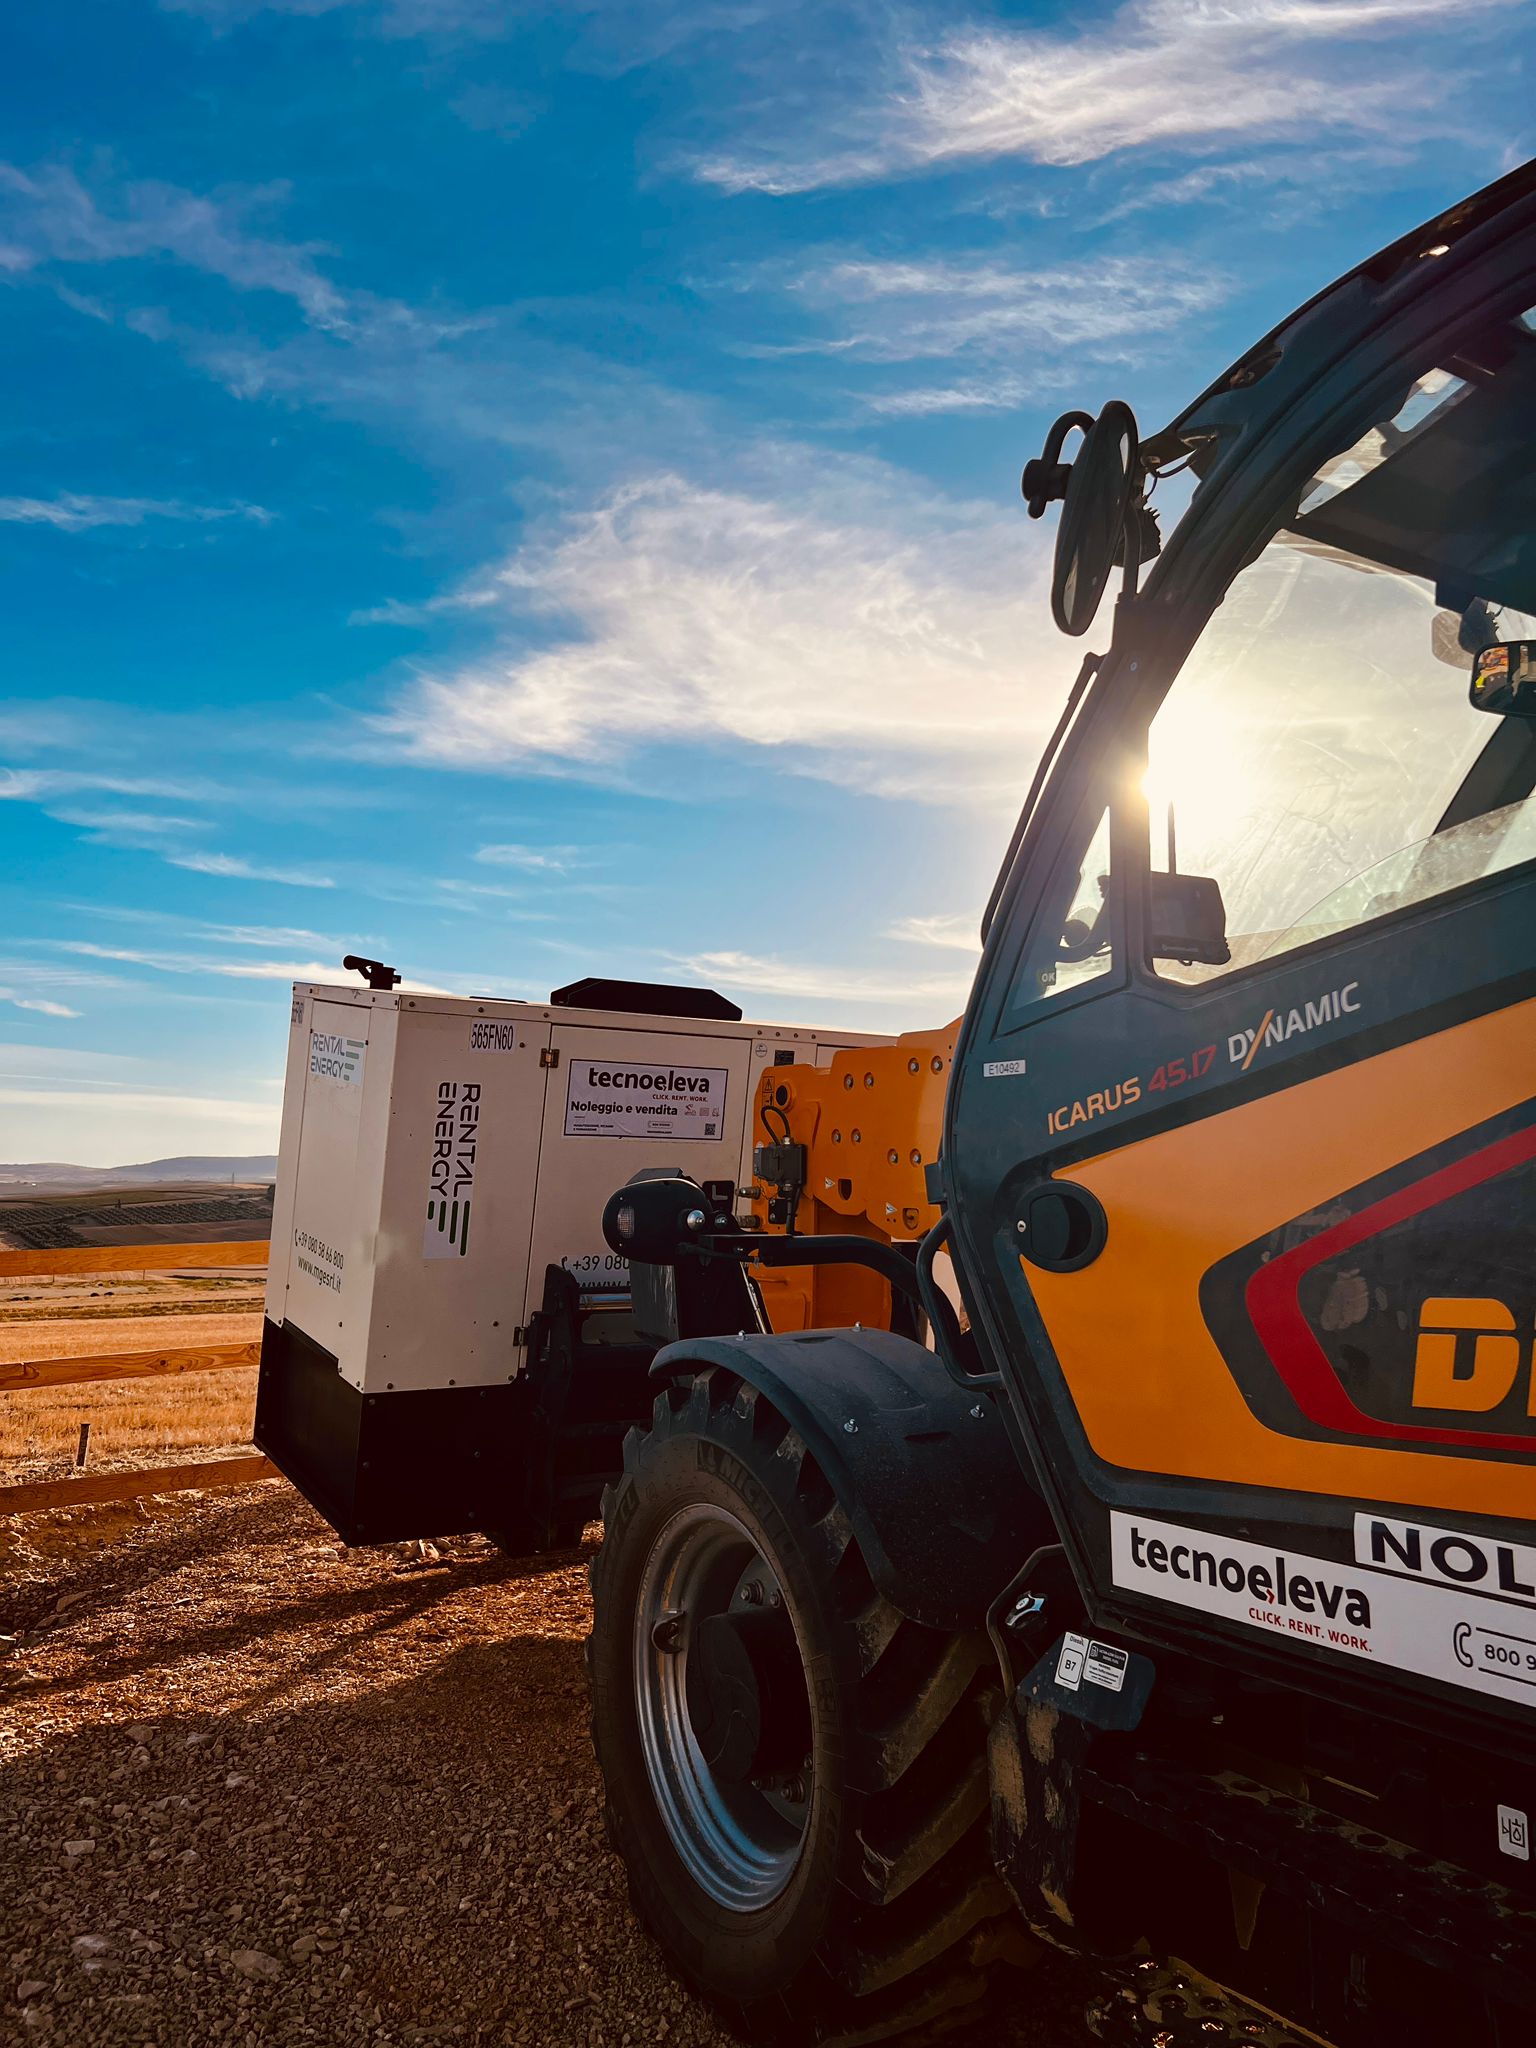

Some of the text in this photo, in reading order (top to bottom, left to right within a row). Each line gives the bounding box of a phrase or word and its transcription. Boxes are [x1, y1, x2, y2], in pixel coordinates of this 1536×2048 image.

[1041, 972, 1056, 983] OK
[312, 1032, 345, 1057] RENTAL
[471, 1023, 514, 1050] 565FN60
[311, 1055, 345, 1079] ENERGY
[988, 1062, 1020, 1075] E10492
[1048, 981, 1362, 1135] ICARUS 45.17 DYNAMIC
[588, 1067, 710, 1093] tecnoeleva
[570, 1101, 678, 1116] Noleggio e vendita
[430, 1081, 458, 1197] ENERGY
[453, 1083, 482, 1198] RENTAL
[298, 1231, 344, 1270] +39 080 58 66 800
[573, 1255, 600, 1271] +39
[1411, 1297, 1536, 1417] D
[1370, 1521, 1536, 1597] NOL
[1130, 1527, 1372, 1629] tecnoeleva
[1248, 1607, 1373, 1652] CLICK. RENT. WORK.
[1065, 1660, 1076, 1672] B7
[1485, 1644, 1520, 1666] 800
